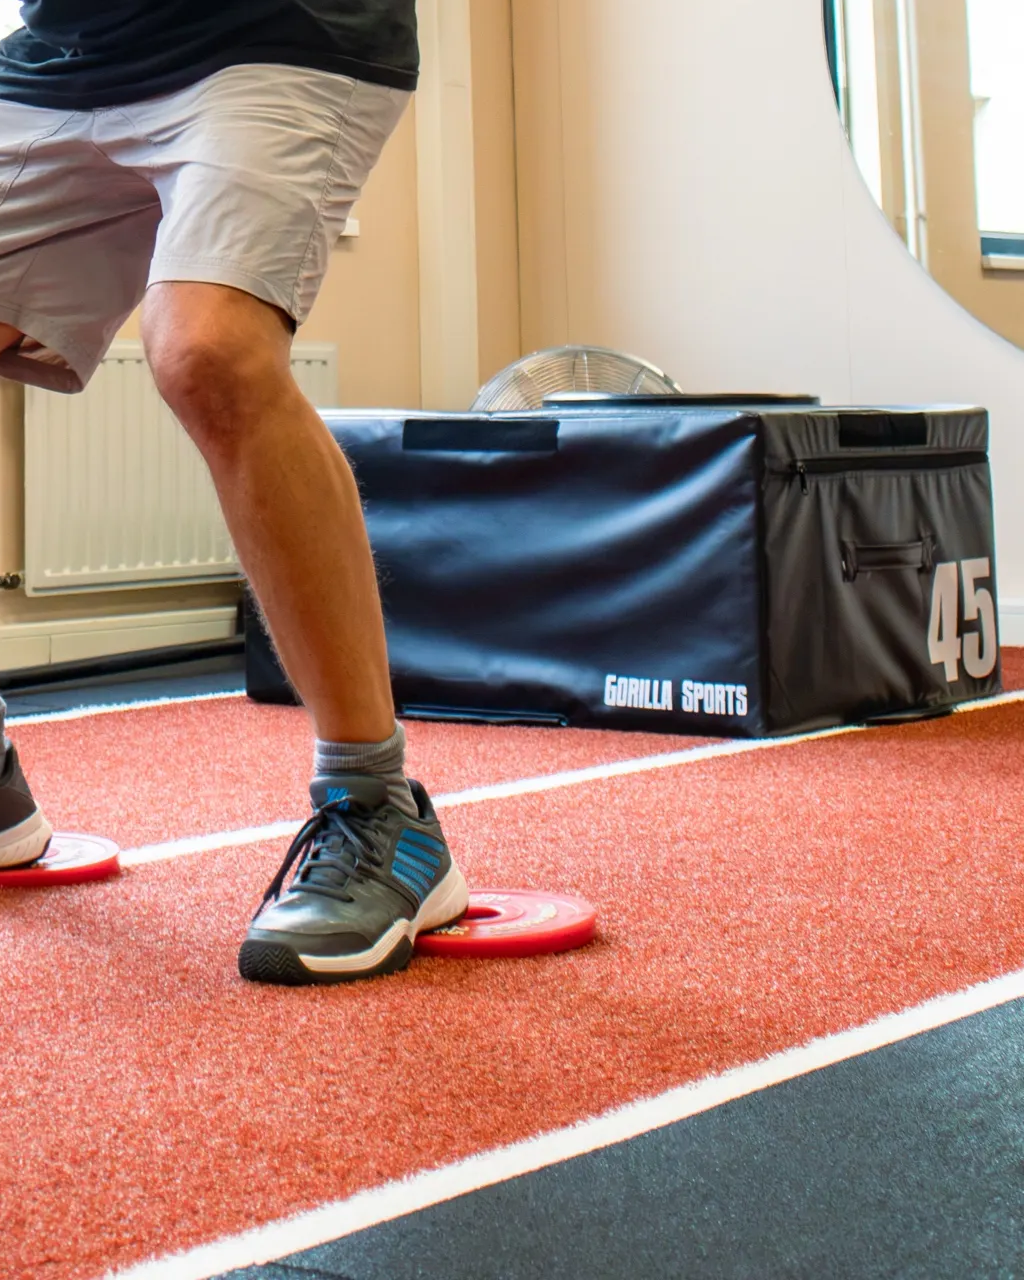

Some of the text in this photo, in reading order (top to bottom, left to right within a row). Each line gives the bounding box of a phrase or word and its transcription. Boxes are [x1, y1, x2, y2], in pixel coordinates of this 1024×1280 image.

[927, 557, 996, 682] 45
[603, 673, 748, 717] GORILLA SPORTS
